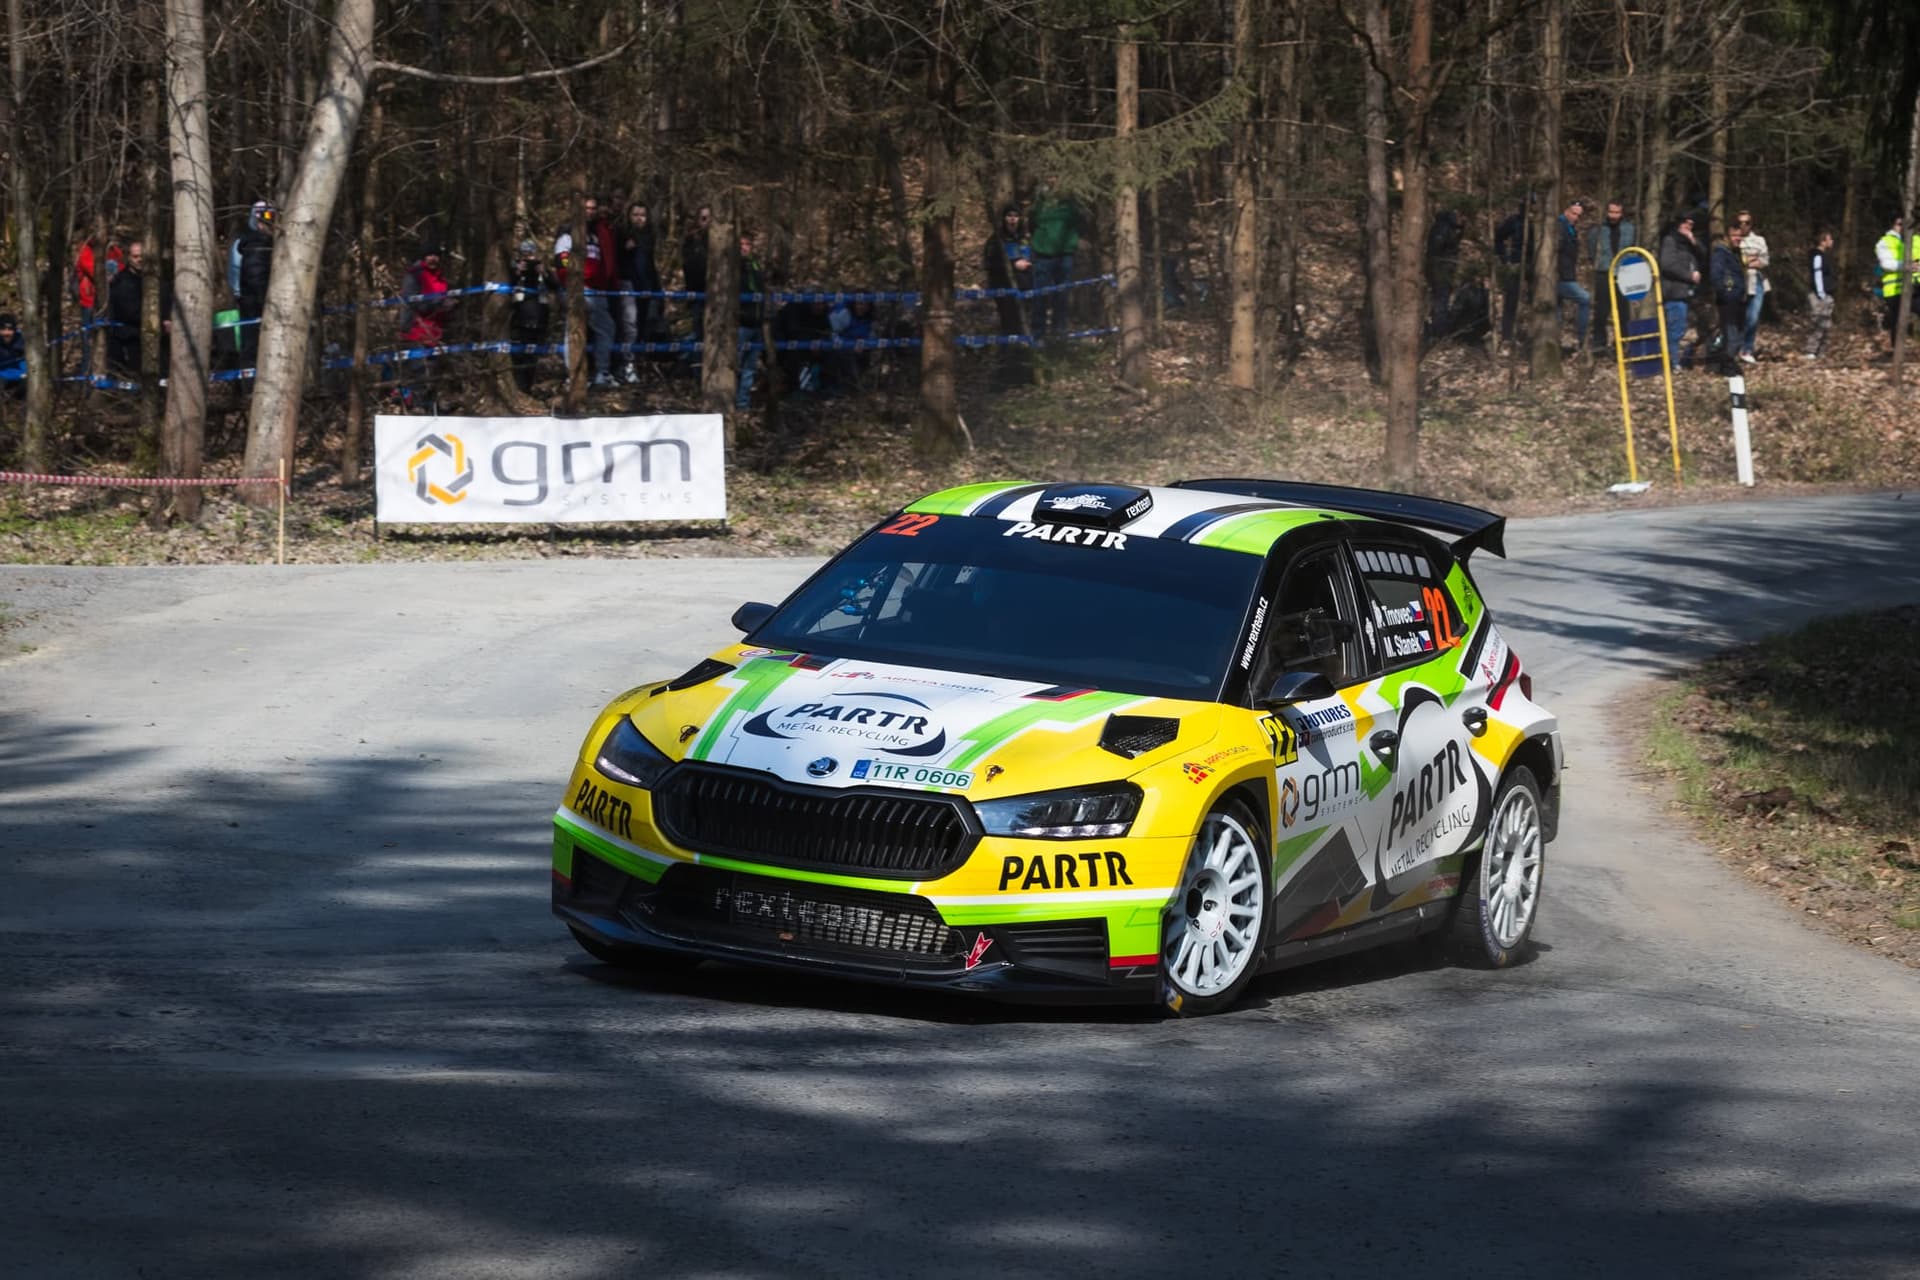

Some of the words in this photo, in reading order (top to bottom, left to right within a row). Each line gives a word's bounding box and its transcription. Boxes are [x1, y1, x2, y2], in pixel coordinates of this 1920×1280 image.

[491, 438, 691, 506] grm
[563, 491, 692, 506] SYSTEMS
[879, 513, 939, 537] 22
[1002, 520, 1128, 551] PARTR
[1240, 595, 1269, 671] www.rexteam.cz
[1422, 586, 1462, 651] 22
[776, 721, 823, 734] METAL
[827, 725, 911, 747] RECYCLING
[784, 703, 929, 736] PARTR
[1262, 715, 1298, 767] 22
[872, 764, 910, 780] 11R
[914, 768, 971, 788] 0606
[1303, 760, 1360, 822] grm
[1387, 738, 1468, 851] PARTR
[573, 778, 634, 841] PARTR
[1415, 804, 1471, 858] RECYCLING
[998, 851, 1134, 892] PARTR
